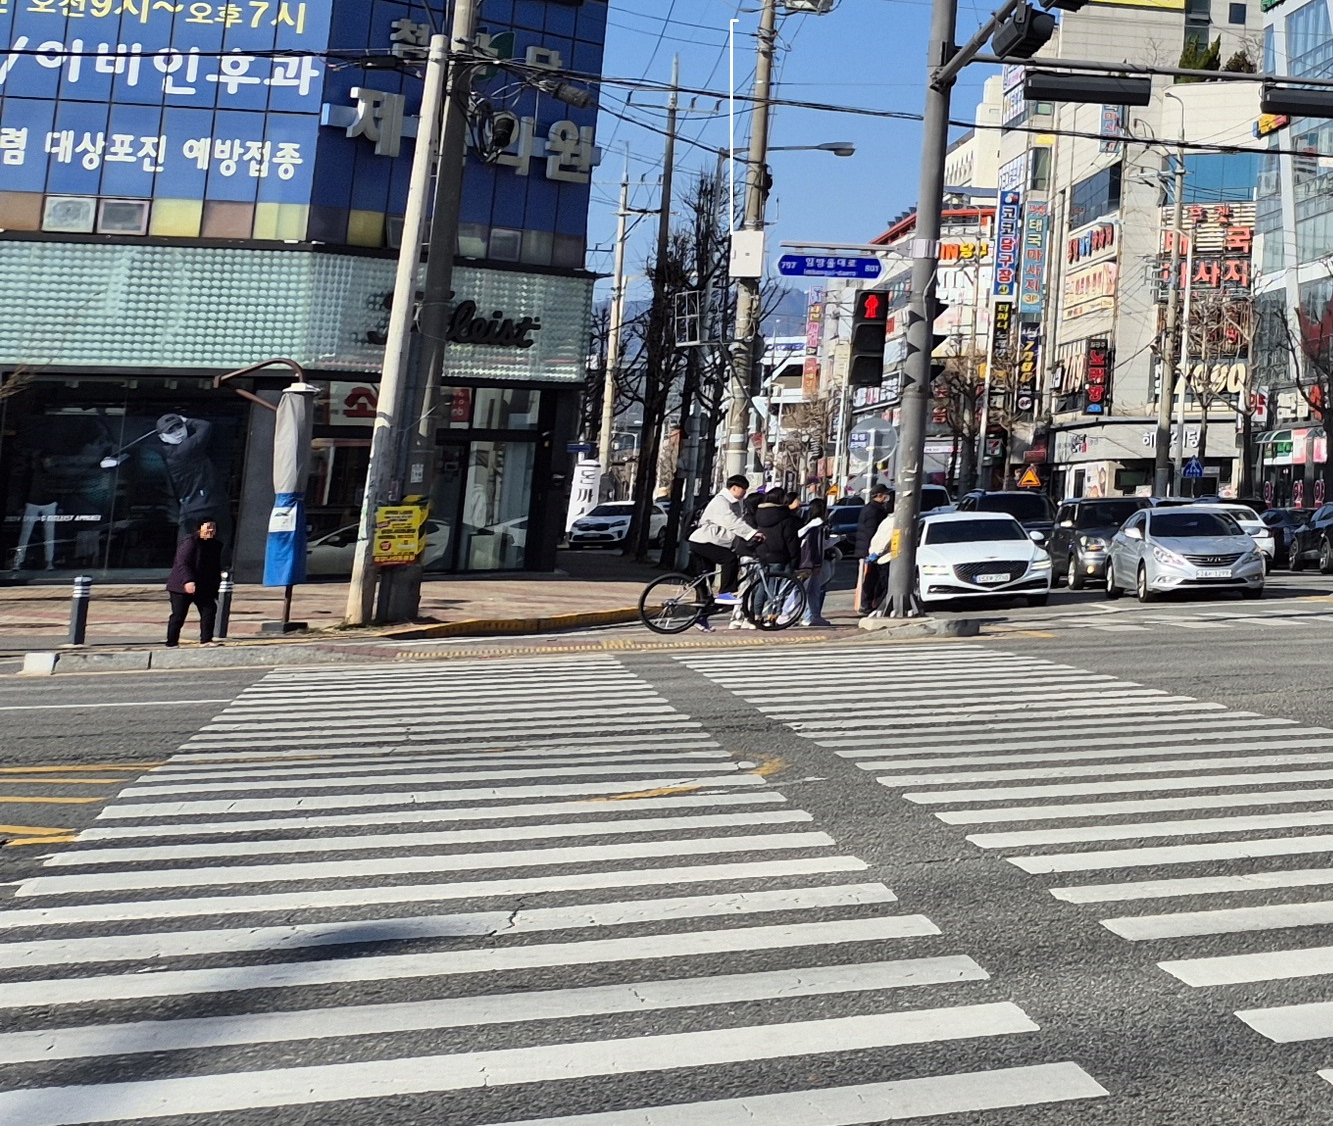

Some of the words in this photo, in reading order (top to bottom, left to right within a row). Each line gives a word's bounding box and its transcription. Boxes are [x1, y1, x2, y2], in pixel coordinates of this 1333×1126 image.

[45, 129, 168, 173] 대상포진
[182, 137, 304, 181] 예방접종
[345, 86, 593, 184] 제의원
[805, 256, 857, 269] 임방울대로
[998, 204, 1017, 283] 코코당구장
[1025, 218, 1043, 292] 태국마사지
[368, 290, 541, 348] leist
